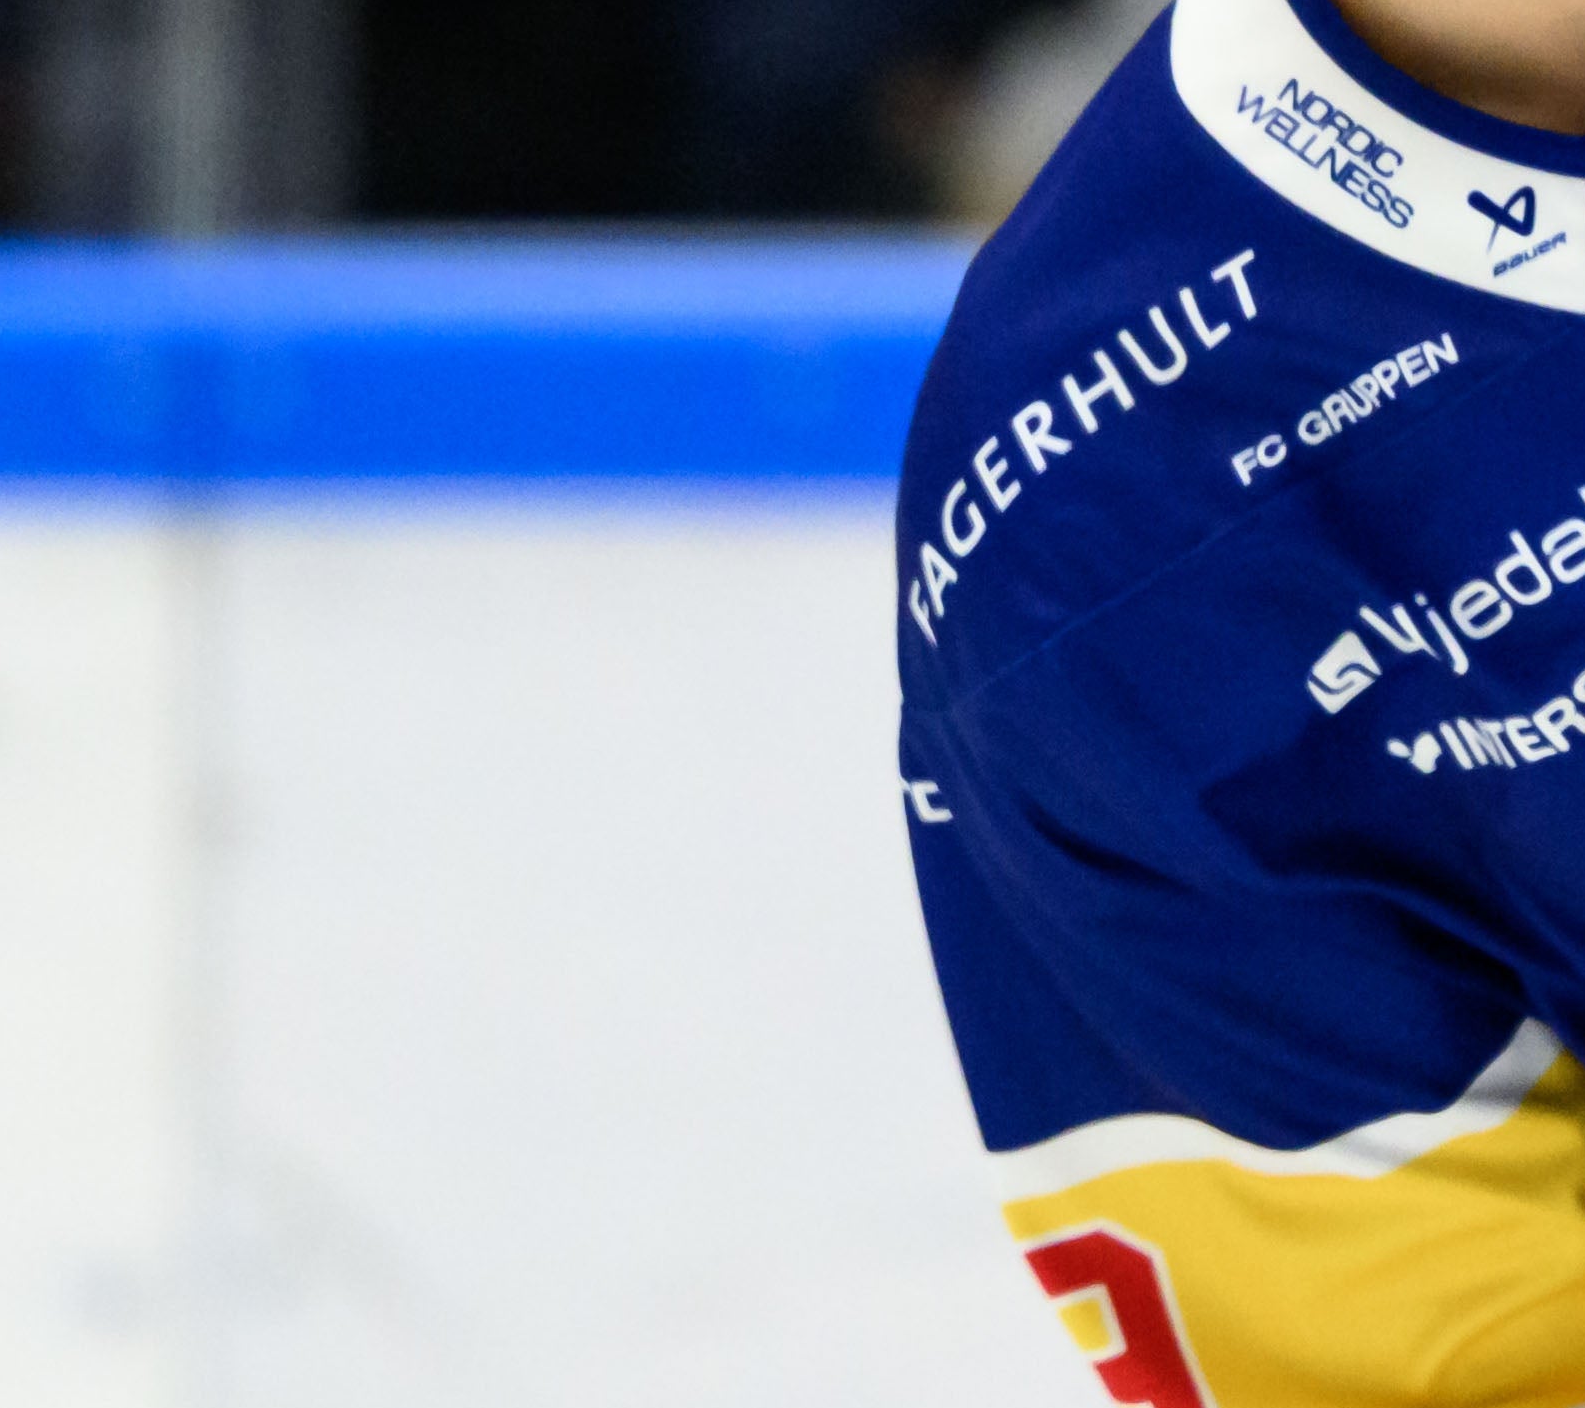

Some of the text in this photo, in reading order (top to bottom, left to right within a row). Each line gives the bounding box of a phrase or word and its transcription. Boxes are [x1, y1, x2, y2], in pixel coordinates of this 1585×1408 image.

[1237, 84, 1415, 229] WELLNESS
[1277, 77, 1404, 179] NORDIC
[907, 248, 1258, 645] FAGERHULT
[1231, 332, 1460, 486] FC GRUPPEN
